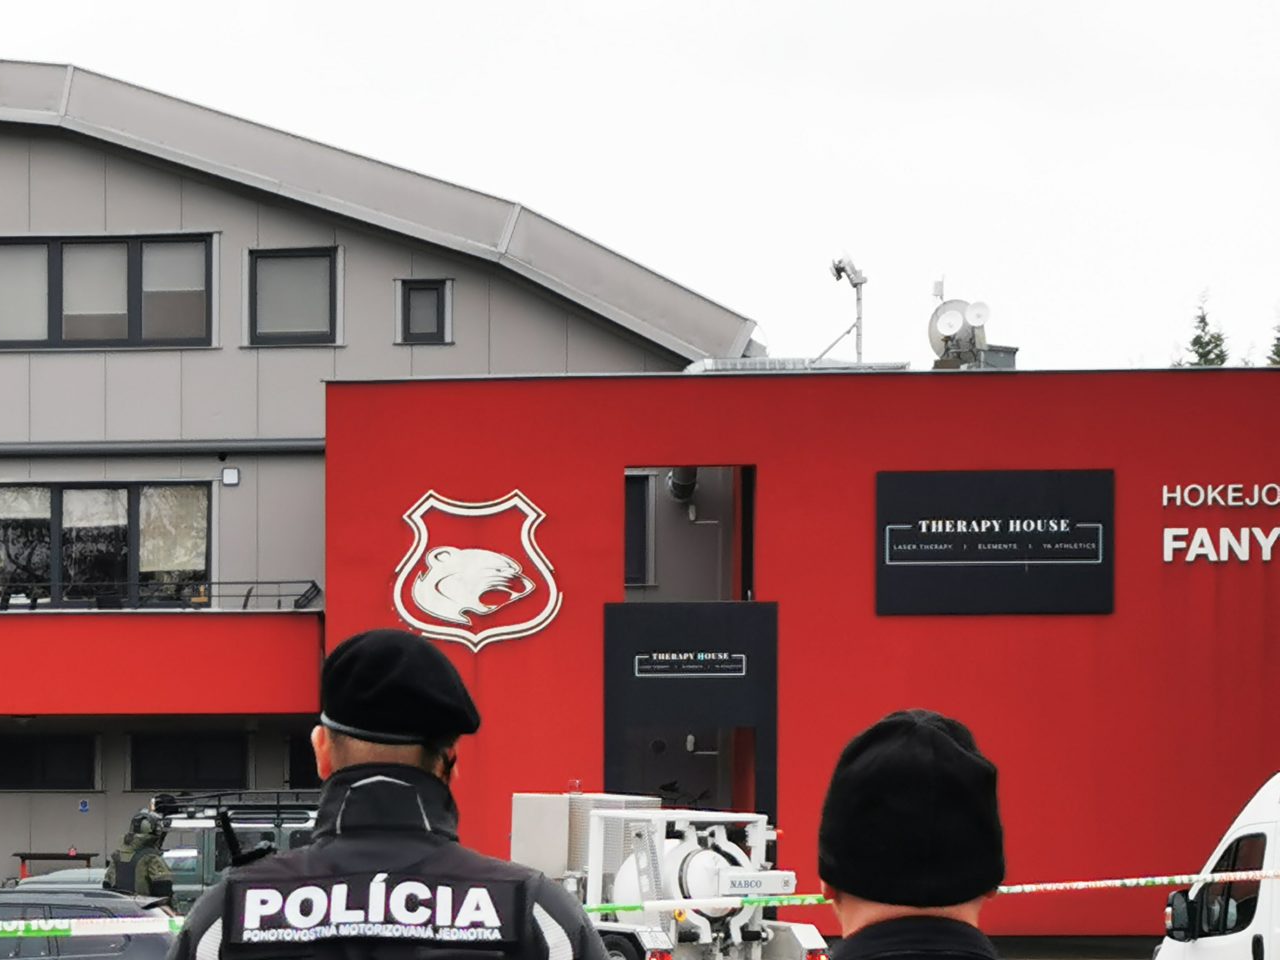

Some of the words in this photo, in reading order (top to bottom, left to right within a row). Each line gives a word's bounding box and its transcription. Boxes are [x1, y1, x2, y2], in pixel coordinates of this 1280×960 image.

[1162, 483, 1280, 507] HOKEJO
[918, 519, 1003, 533] THERAPY
[1008, 518, 1070, 532] HOUSE
[1163, 527, 1280, 562] FANY
[652, 652, 694, 660] THERAPY
[697, 652, 729, 660] HOUSE
[729, 880, 762, 889] NABCO
[243, 873, 502, 929] POLÍCIA
[435, 926, 502, 941] JEDNOTKA
